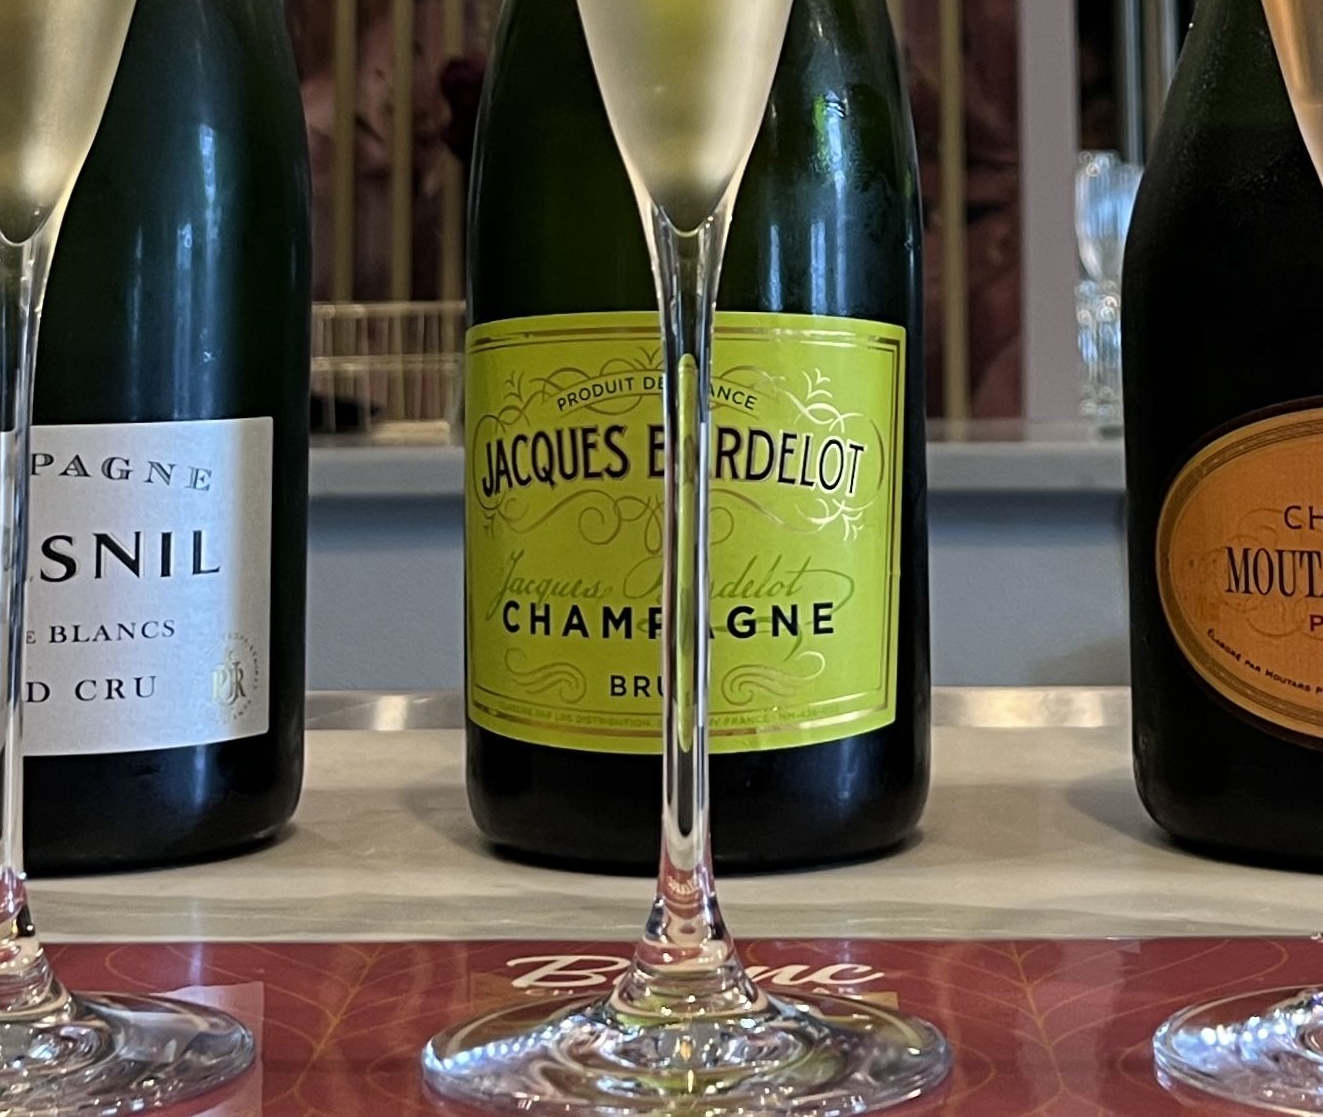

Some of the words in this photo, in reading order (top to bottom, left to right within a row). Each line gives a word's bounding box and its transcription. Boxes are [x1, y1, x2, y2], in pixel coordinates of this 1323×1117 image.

[556, 376, 635, 412] PRODUIT
[480, 423, 631, 497] JACQUES
[648, 423, 865, 497] BRDELOT
[48, 619, 176, 644] BLANCS
[501, 600, 835, 640] CHAMPGNE
[74, 675, 158, 702] CRU
[506, 954, 885, 989] Bnc
